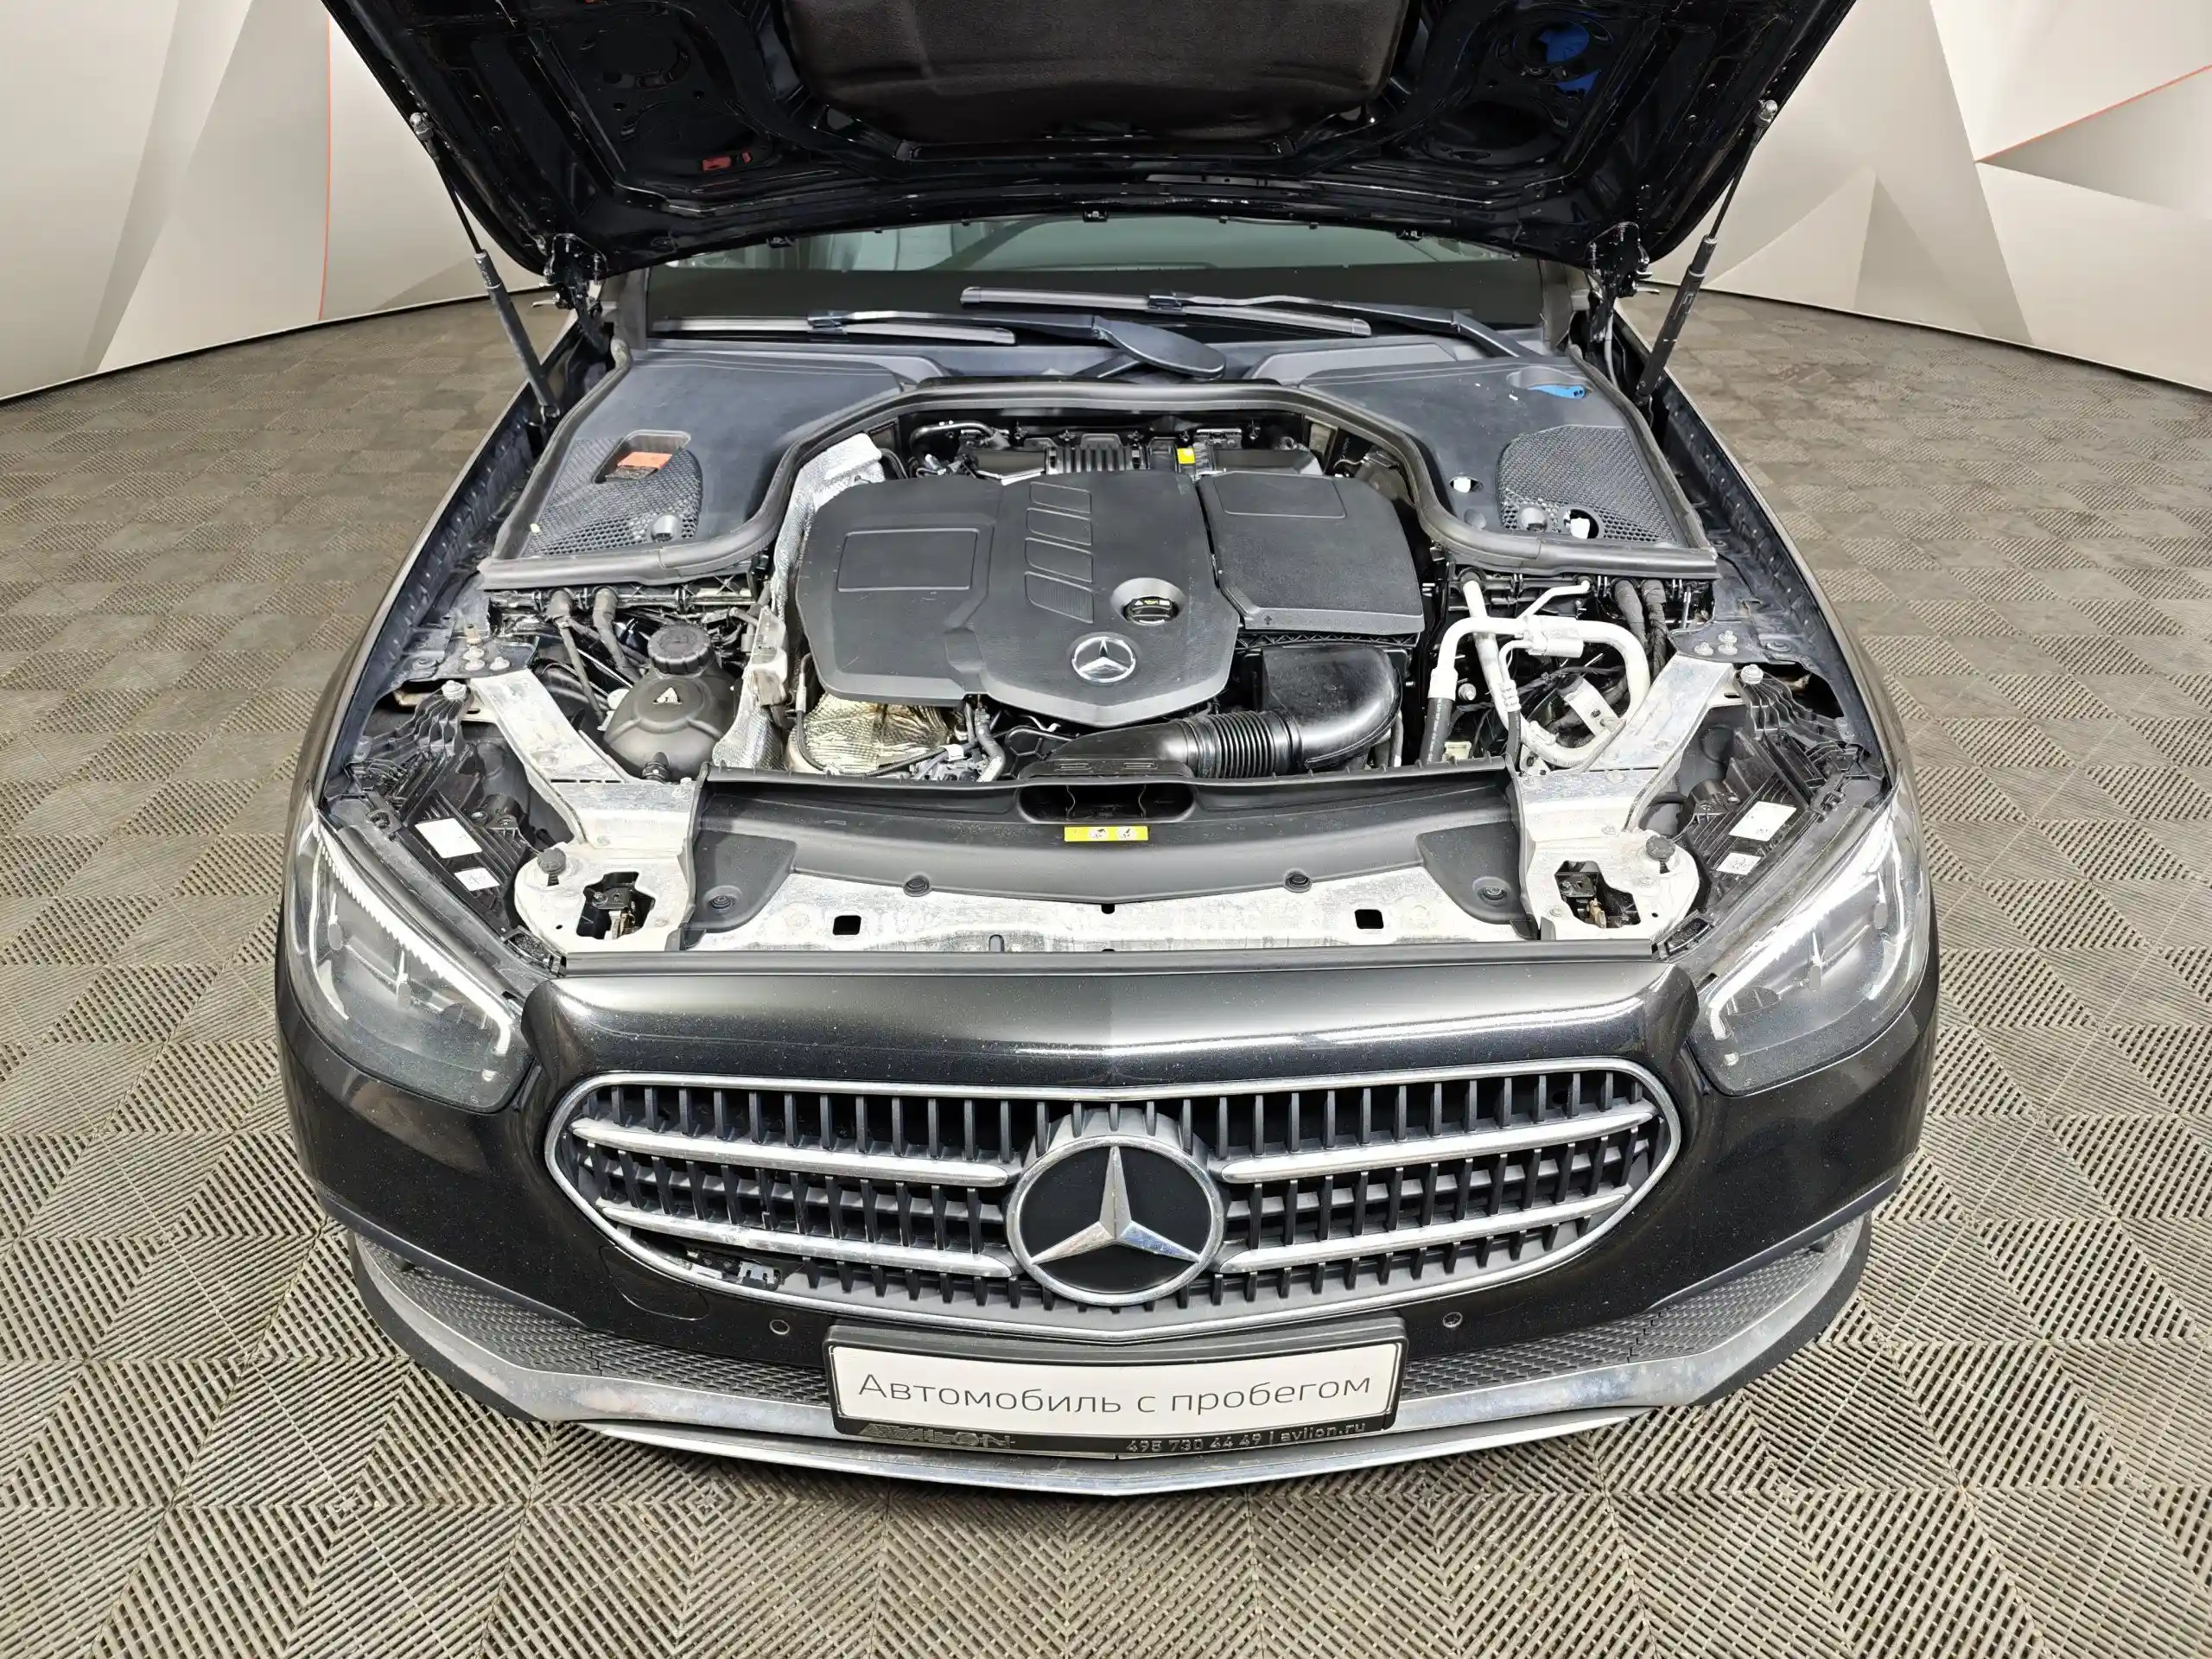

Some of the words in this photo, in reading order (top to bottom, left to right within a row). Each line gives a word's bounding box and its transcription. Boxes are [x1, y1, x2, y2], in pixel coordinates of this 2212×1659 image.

[858, 1373, 1122, 1413] Автомобиль
[1137, 1395, 1156, 1413] с
[1171, 1377, 1370, 1415] пробегом
[1125, 1439, 1162, 1452] 495
[1168, 1439, 1205, 1452] 730
[1210, 1436, 1234, 1450] 44
[1239, 1433, 1261, 1447] 49
